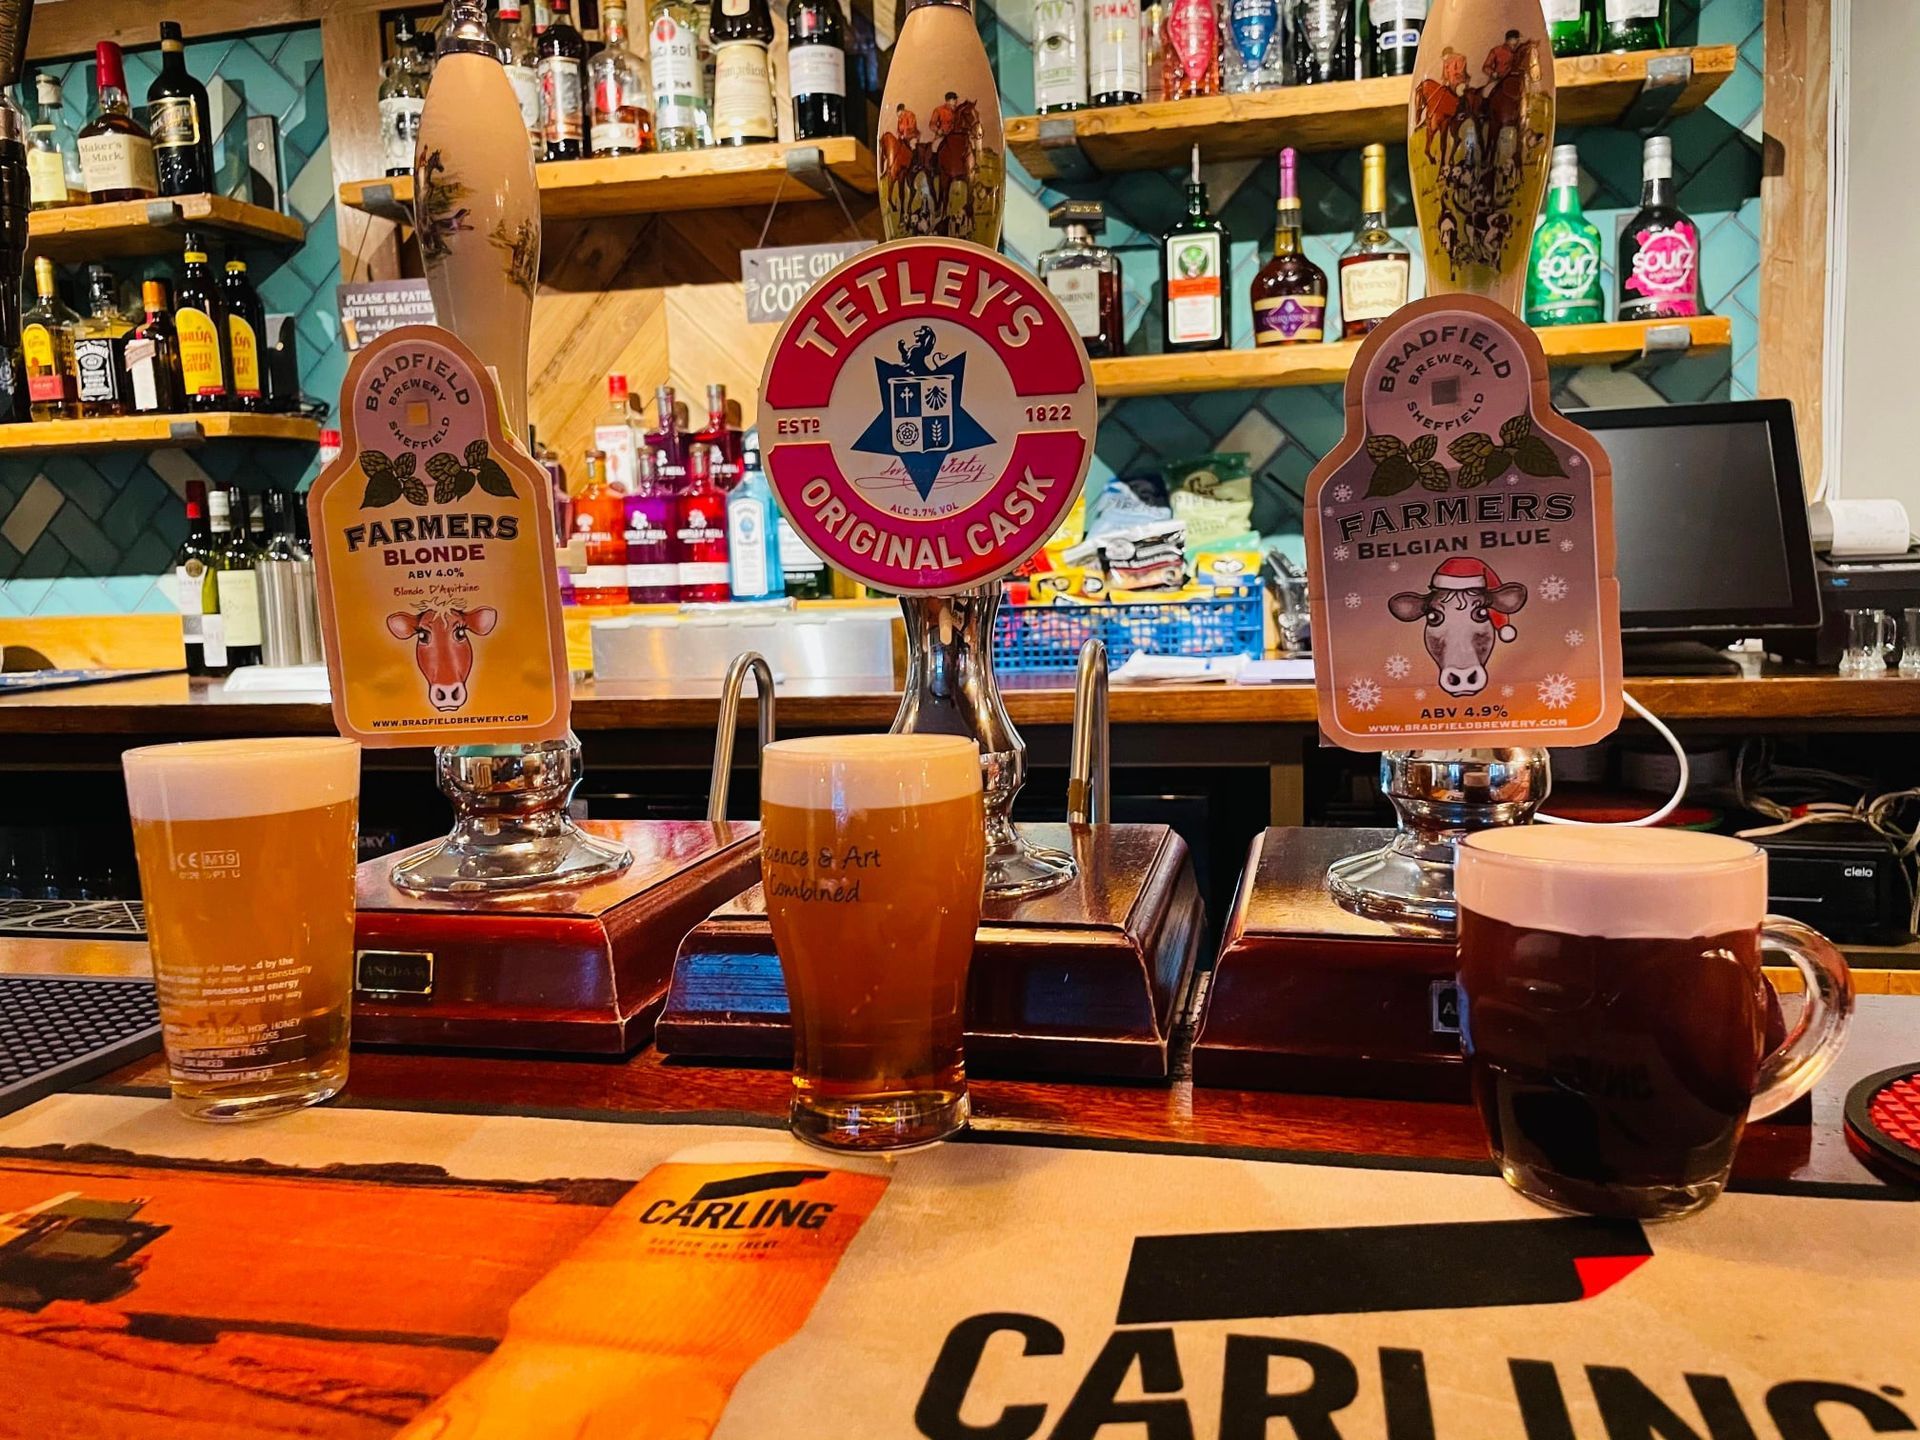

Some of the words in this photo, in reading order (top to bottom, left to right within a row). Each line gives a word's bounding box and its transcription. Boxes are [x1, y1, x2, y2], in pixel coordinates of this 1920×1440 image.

[80, 142, 122, 153] Maker's
[767, 255, 804, 281] THE
[809, 252, 845, 278] GIN
[346, 293, 384, 306] PLEASE
[385, 292, 400, 303] BE
[795, 259, 1044, 359] TETLEY'S
[369, 305, 388, 317] THE
[1378, 325, 1512, 393] BRADFIELD
[1408, 353, 1482, 386] BREWERY
[366, 353, 470, 412] BRADFIELD
[388, 378, 447, 406] BREWERY
[1025, 405, 1072, 423] 1822
[1407, 392, 1485, 431] SHEFFIELD
[388, 416, 450, 450] SHEFFIELD
[801, 477, 963, 571] ORIGINAL
[966, 464, 1057, 556] CASK
[890, 504, 909, 516] ALC
[912, 508, 937, 518] 3.7%
[939, 502, 960, 514] VOL
[1336, 492, 1576, 545] FARMERS
[343, 512, 519, 552] FARMERS
[1357, 535, 1469, 560] BELGIAN
[1479, 527, 1551, 550] BLUE
[383, 543, 486, 566] BLONDE
[408, 570, 432, 579] ABV
[435, 567, 465, 579] 4.0%
[393, 586, 425, 597] Blonde
[372, 714, 529, 728] WWW.BRADFIELDBREWERY.COM
[1420, 707, 1458, 720] ABV
[1464, 704, 1509, 718] 4.9%
[1368, 718, 1568, 733] WWW.BRADFIELDBREWERY.COM
[819, 847, 832, 868] &
[843, 845, 881, 869] Art
[1844, 865, 1874, 878] cielo
[770, 873, 860, 903] Combined
[265, 959, 276, 969] by
[267, 980, 299, 991] energy
[269, 993, 283, 1001] the
[271, 1017, 300, 1031] HONEY
[639, 1199, 838, 1230] CARLING
